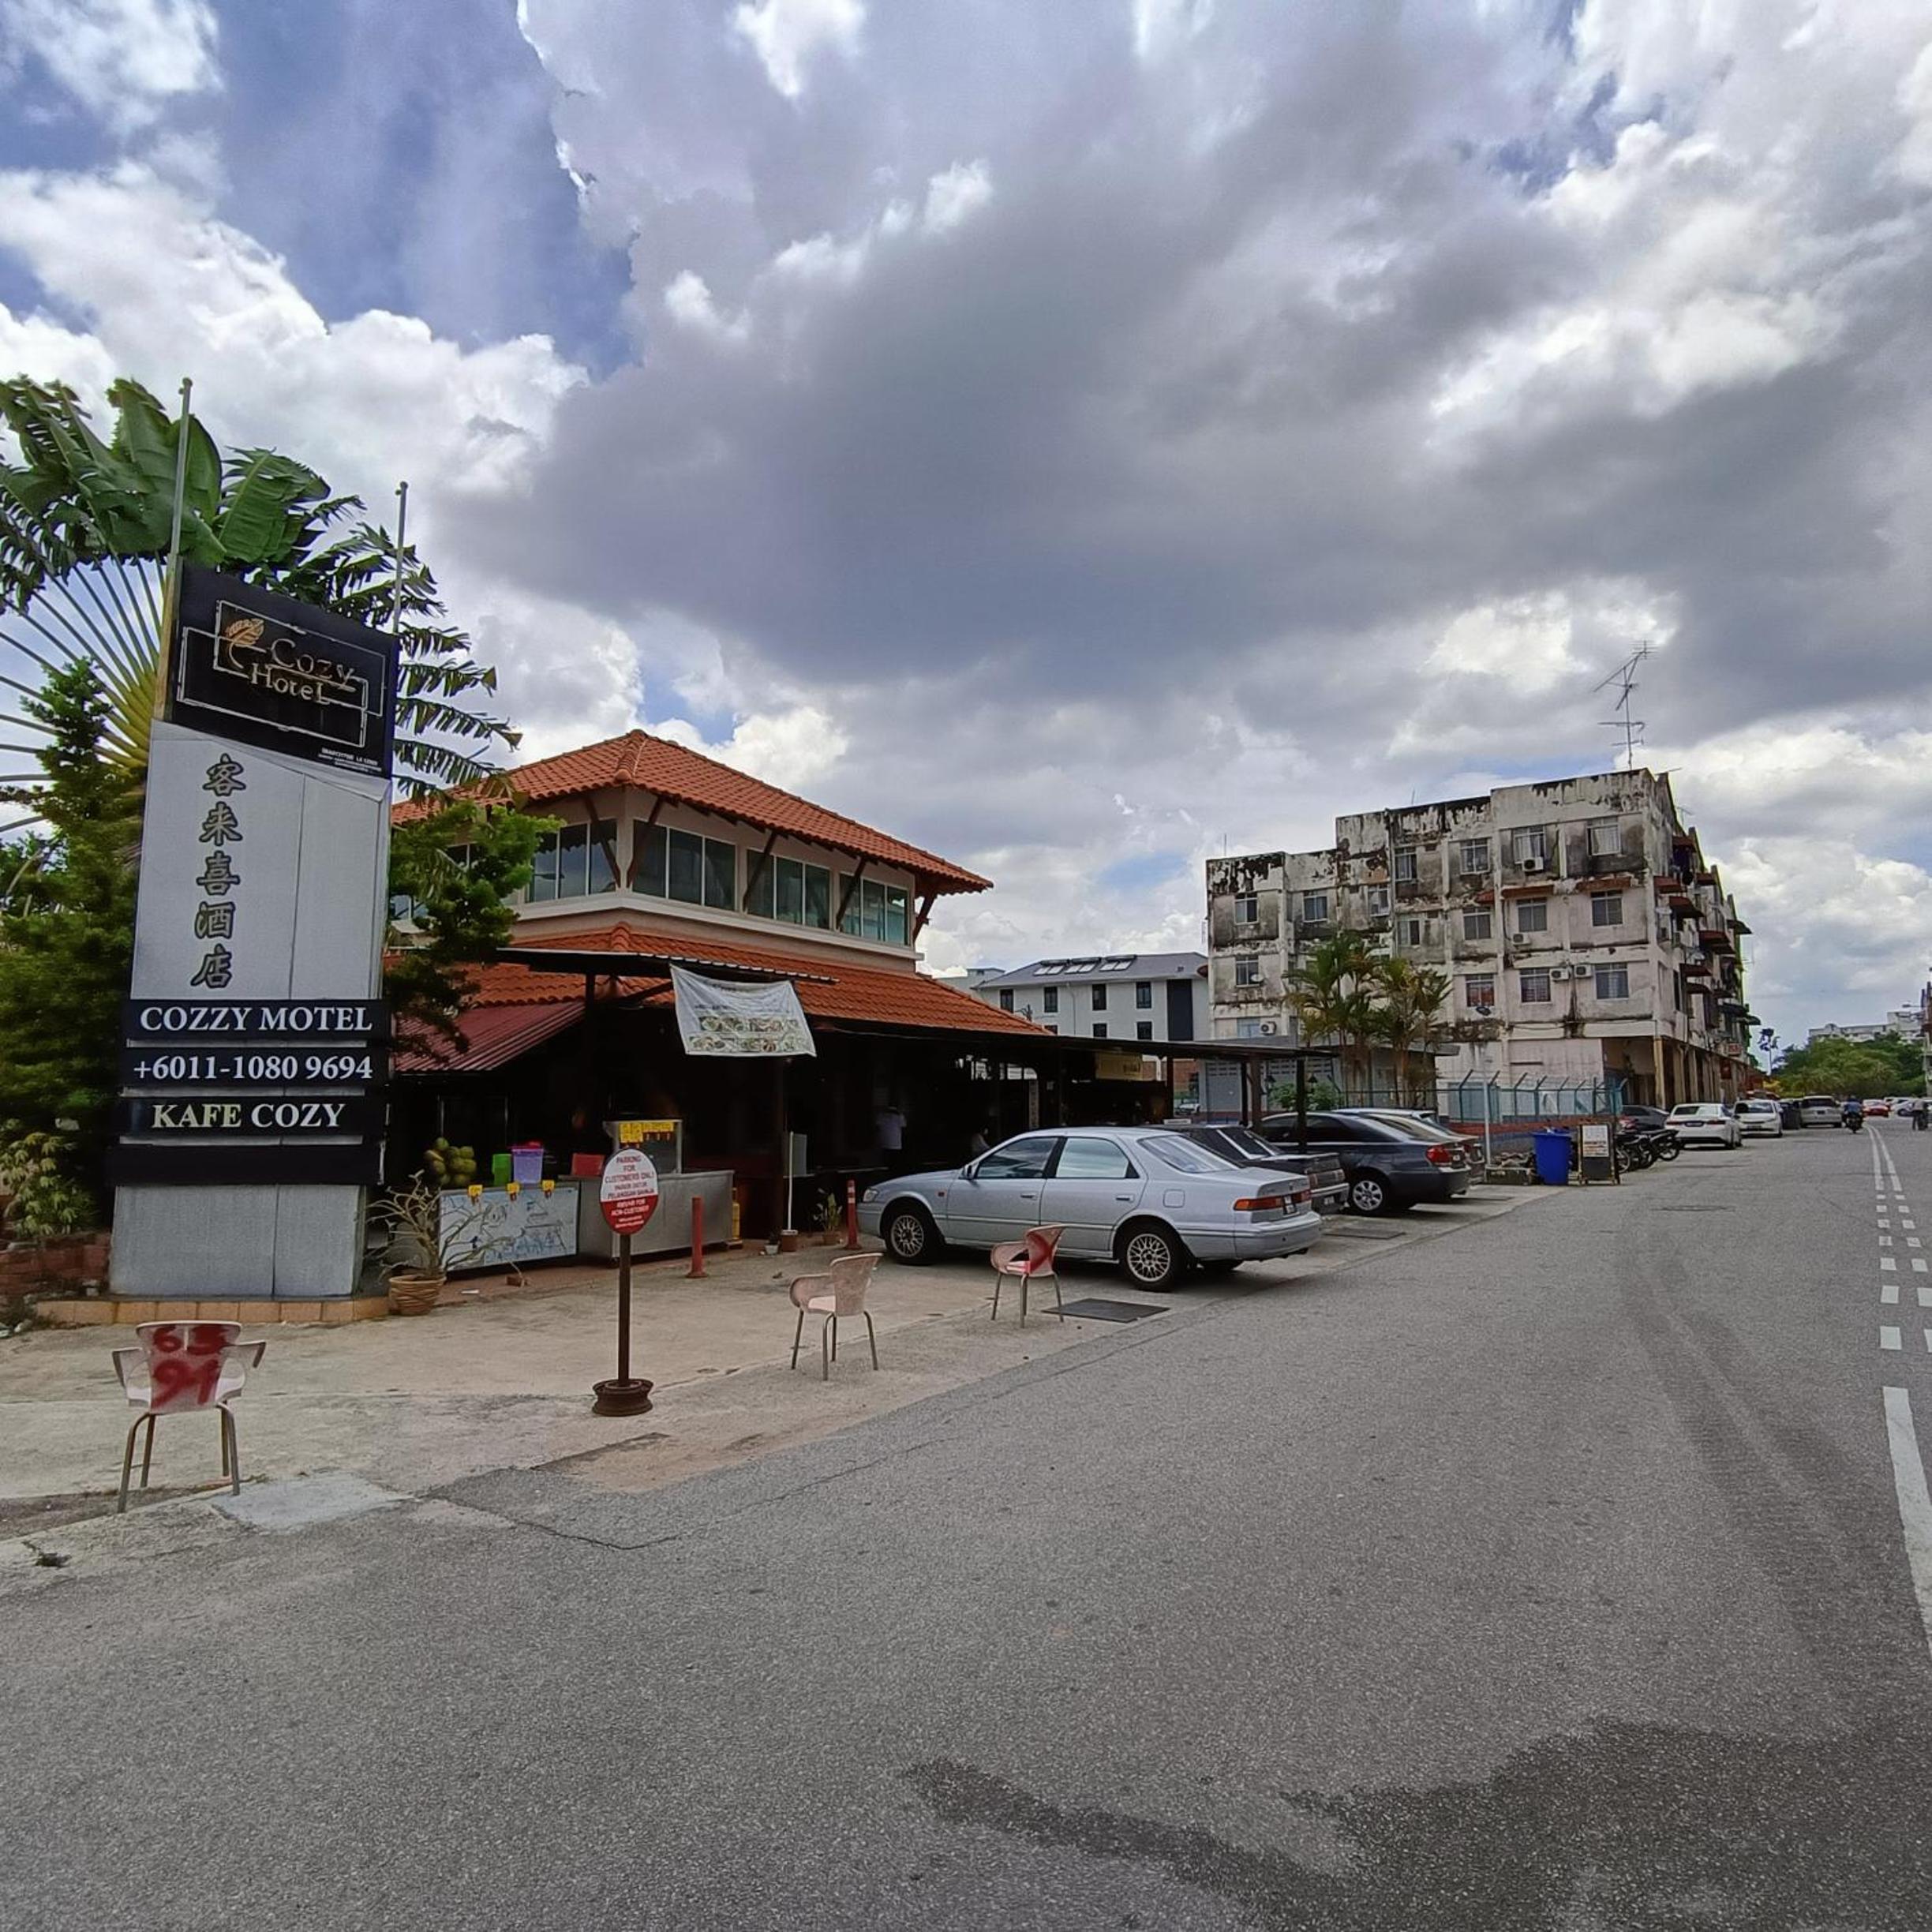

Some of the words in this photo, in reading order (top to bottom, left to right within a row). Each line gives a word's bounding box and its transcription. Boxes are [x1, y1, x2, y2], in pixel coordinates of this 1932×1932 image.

[190, 753, 246, 987] 客来喜酒店
[140, 1007, 253, 1032] COZZY
[258, 1007, 373, 1031] MOTEL
[133, 1056, 298, 1080] +6011-1080
[305, 1056, 373, 1080] 9694
[152, 1104, 242, 1129] KAFE
[251, 1103, 345, 1128] COZY
